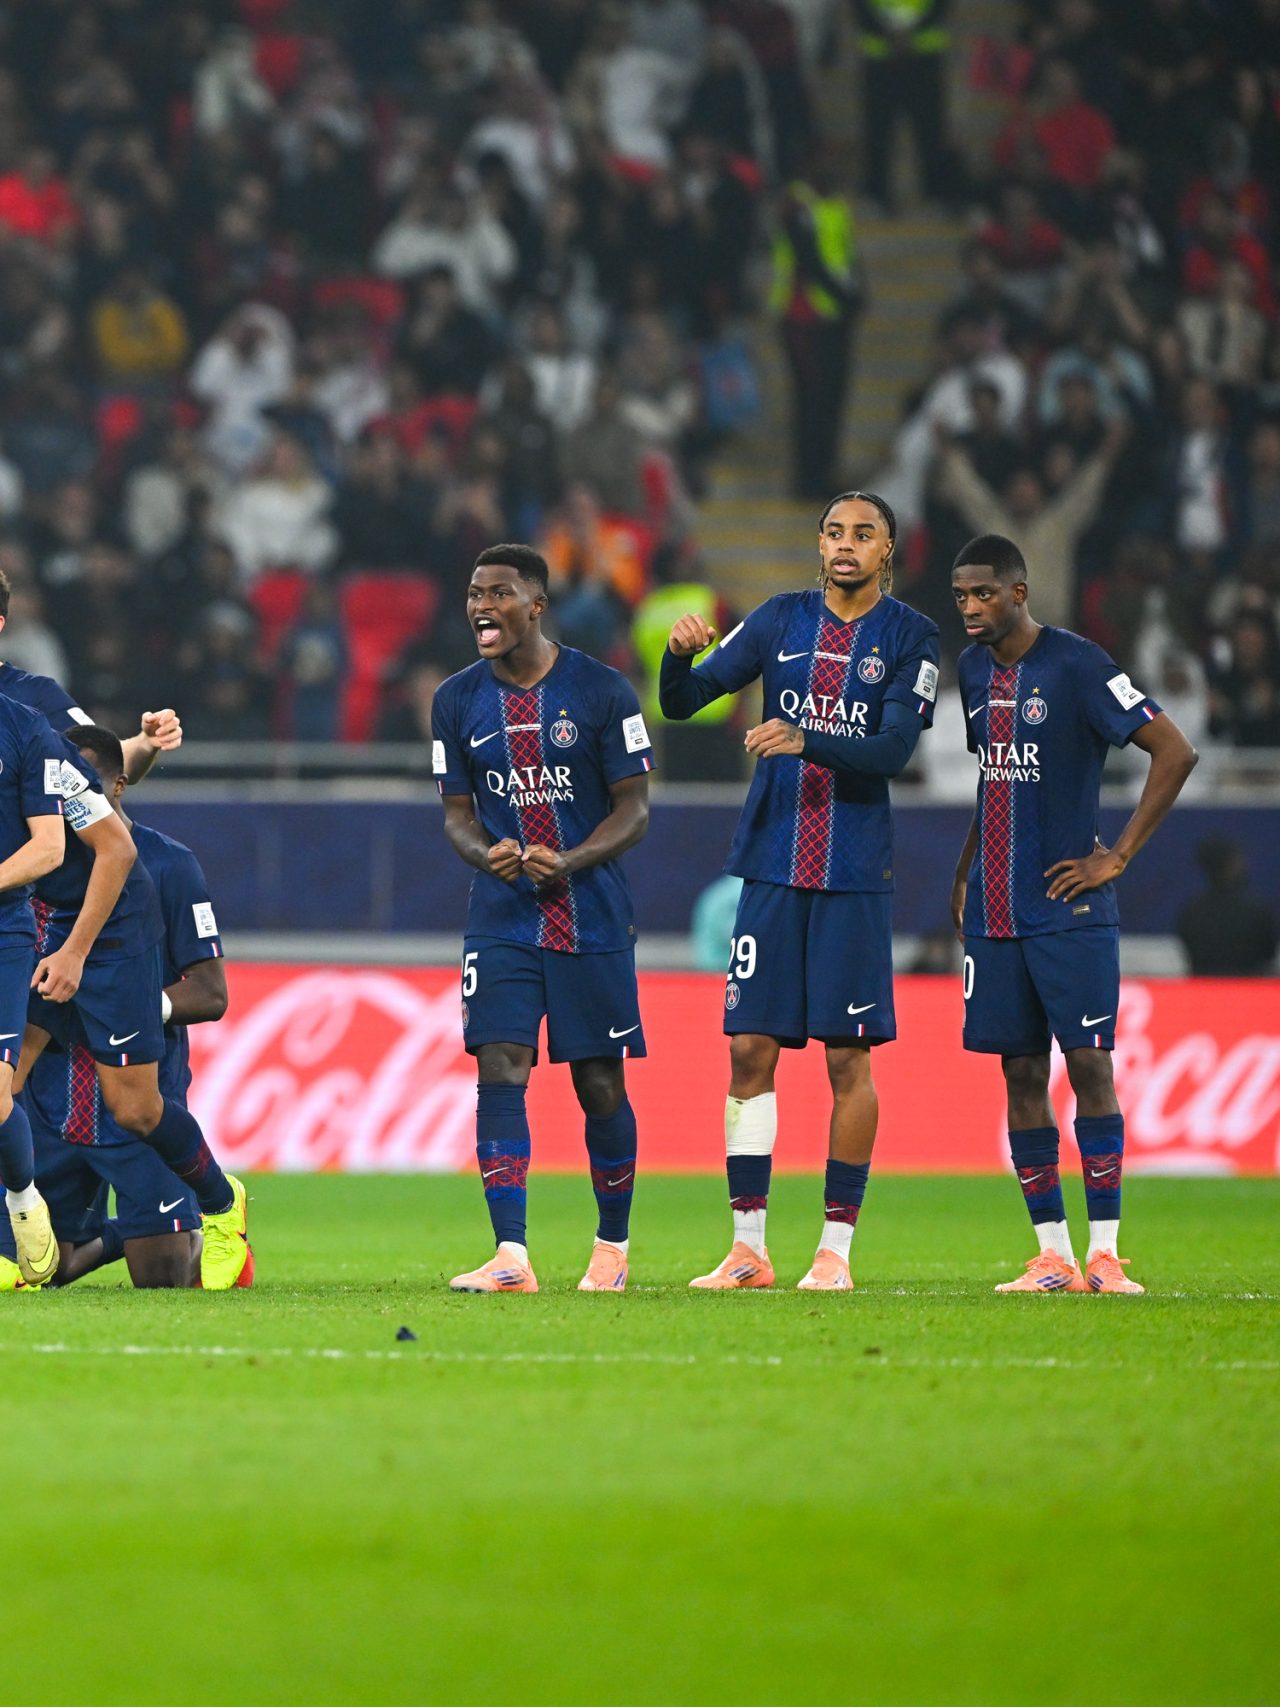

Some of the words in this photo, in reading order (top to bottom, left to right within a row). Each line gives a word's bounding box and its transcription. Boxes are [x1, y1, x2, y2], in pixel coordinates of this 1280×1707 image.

[780, 689, 868, 724] QATAR
[798, 717, 866, 739] AIRWAYS
[486, 766, 572, 796] QATAR
[509, 788, 574, 807] AIRWAYS
[462, 952, 478, 997] 5
[963, 955, 975, 999] 0
